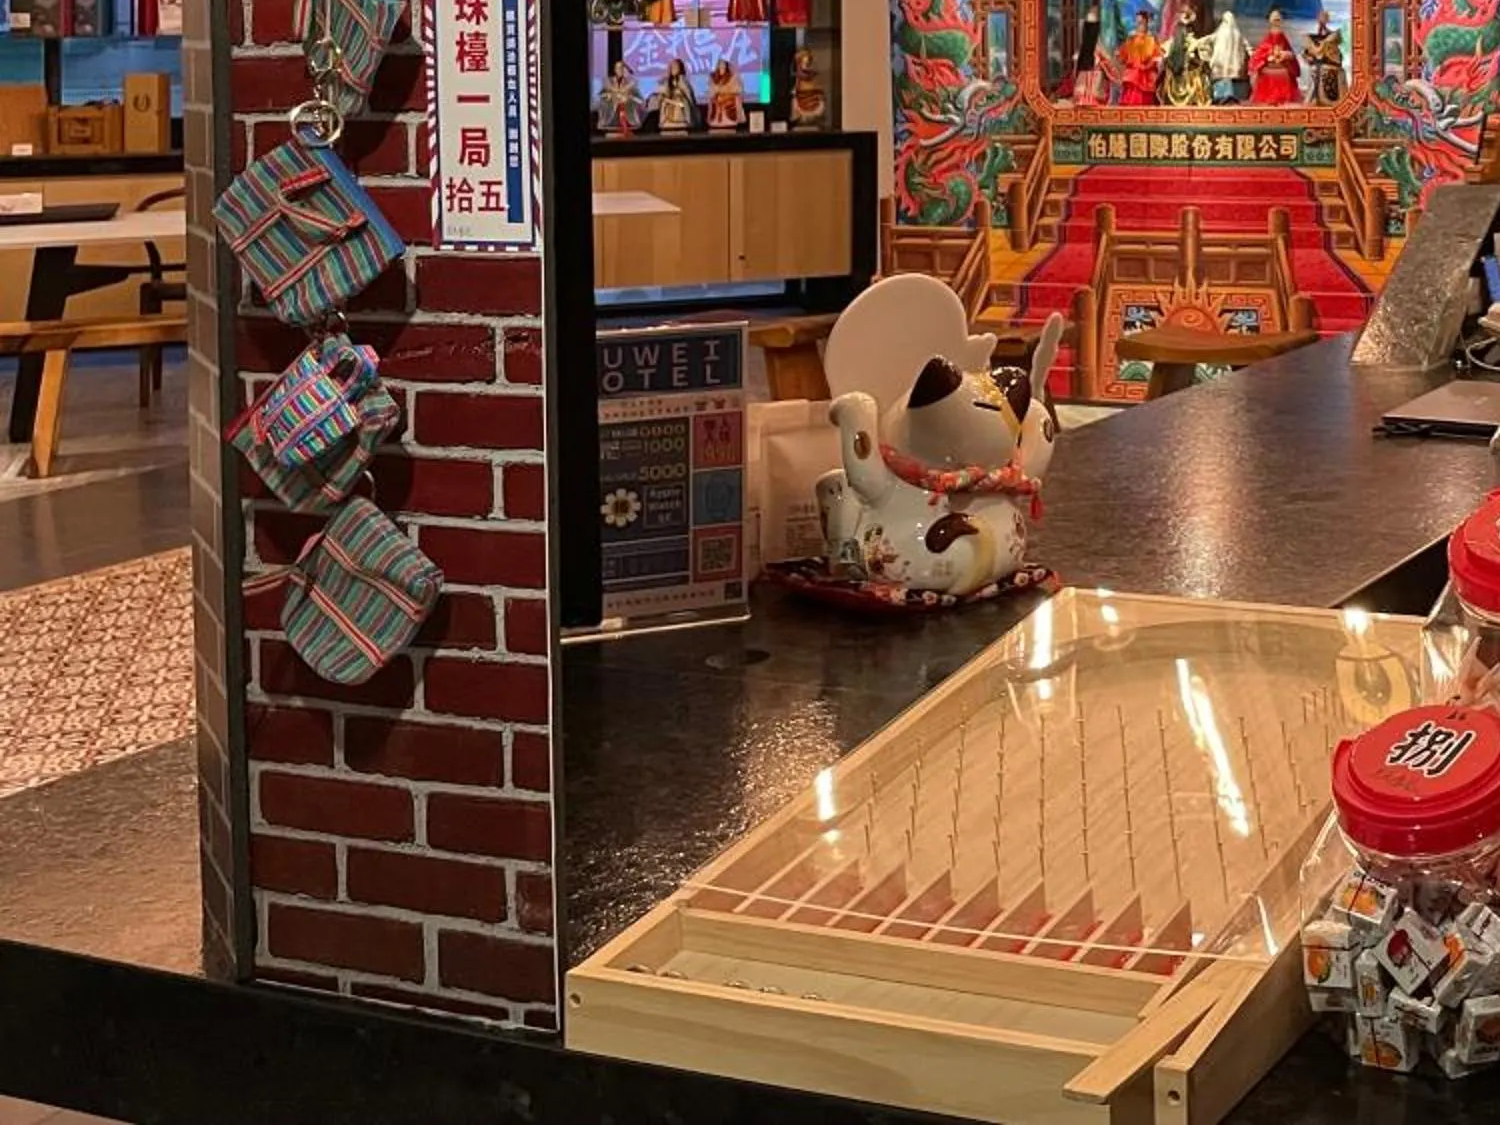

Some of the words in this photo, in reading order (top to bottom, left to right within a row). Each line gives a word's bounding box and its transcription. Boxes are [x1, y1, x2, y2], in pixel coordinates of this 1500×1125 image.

[602, 339, 722, 367] UWEI
[602, 364, 721, 392] OTEL
[1387, 721, 1474, 776] 捌
